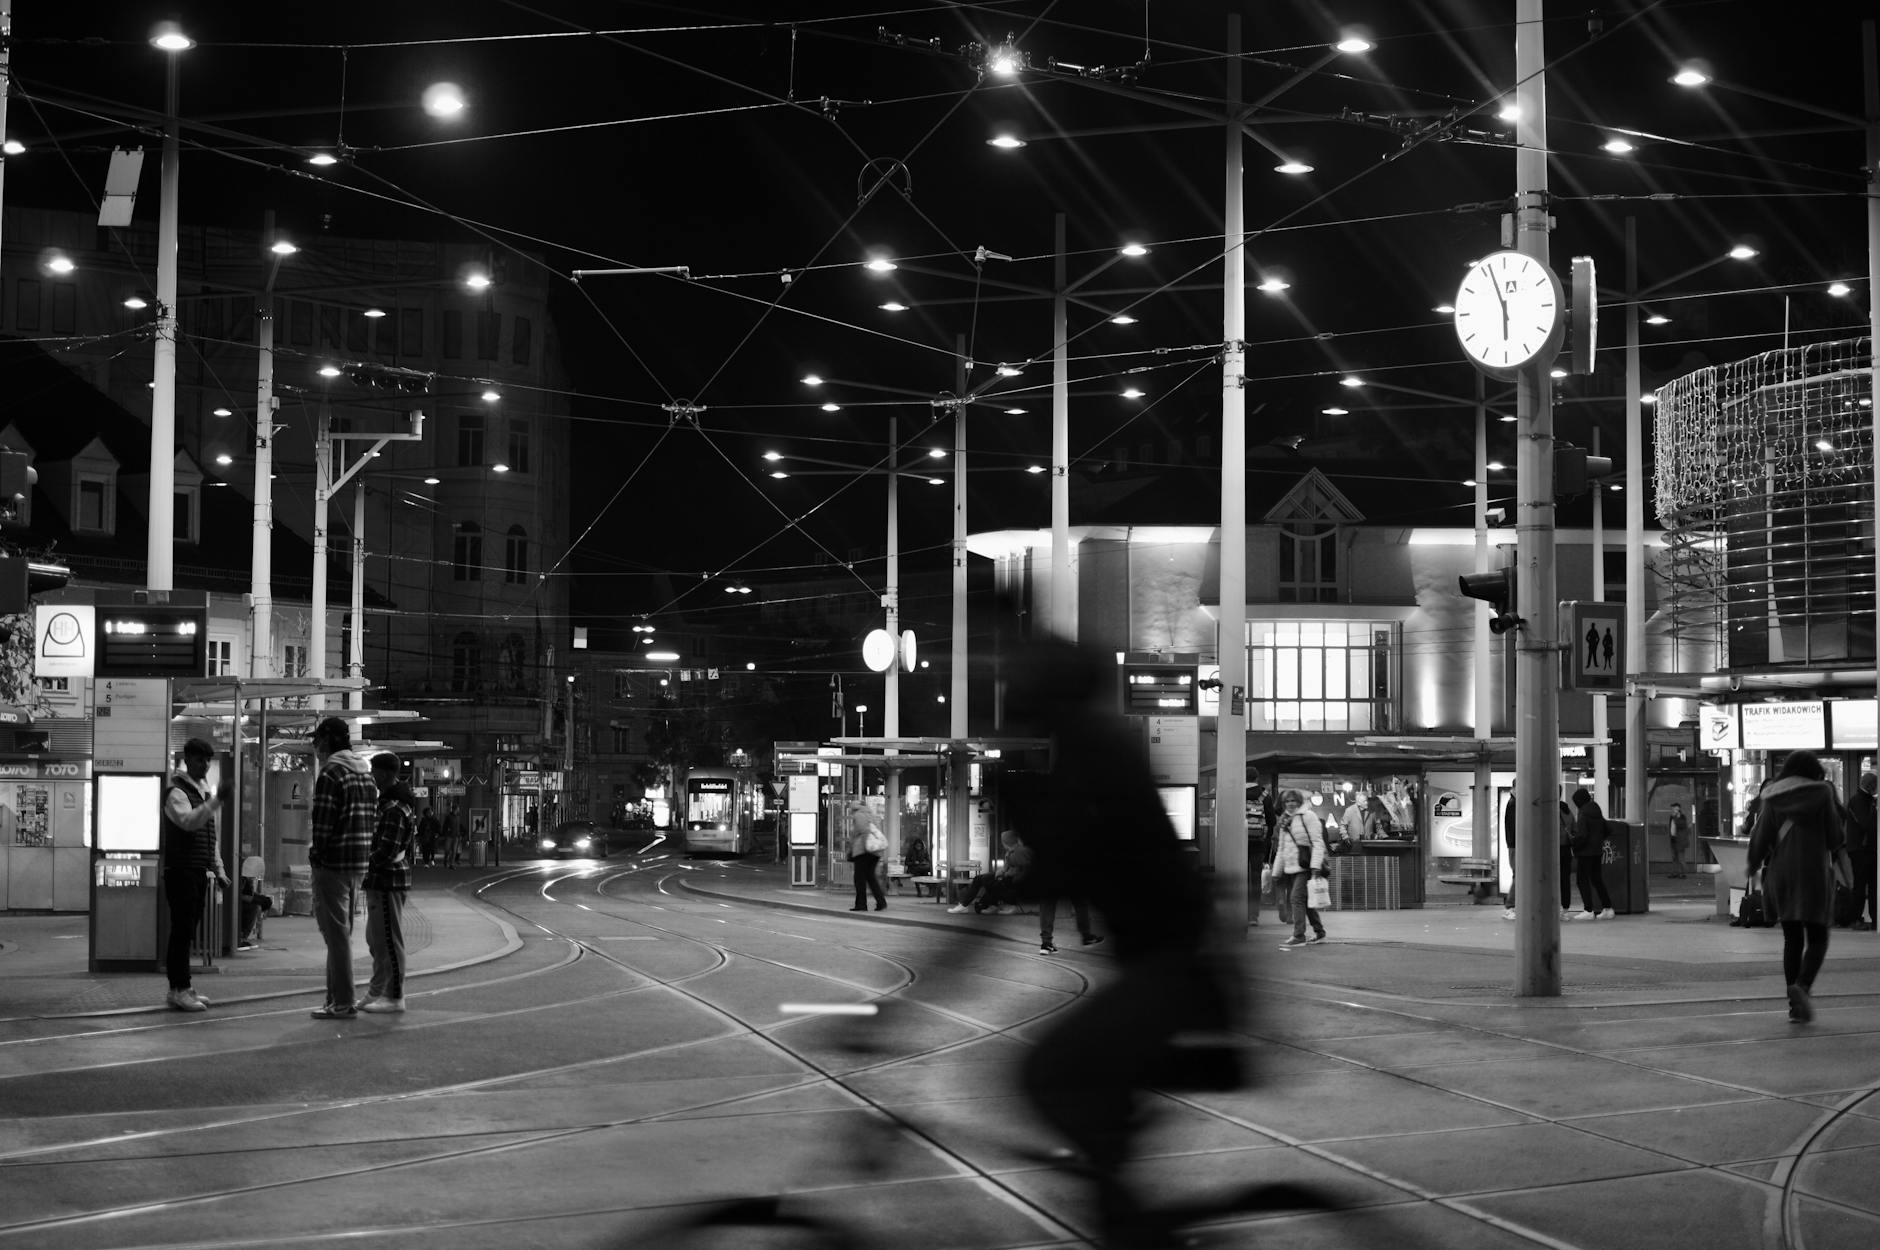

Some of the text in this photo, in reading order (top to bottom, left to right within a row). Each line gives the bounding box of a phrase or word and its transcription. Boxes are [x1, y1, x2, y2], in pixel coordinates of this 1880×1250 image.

[106, 681, 112, 690] 4
[106, 694, 112, 703] 5
[1744, 704, 1822, 716] TRAFIK WIDAKOWICH
[44, 763, 79, 776] TOTO
